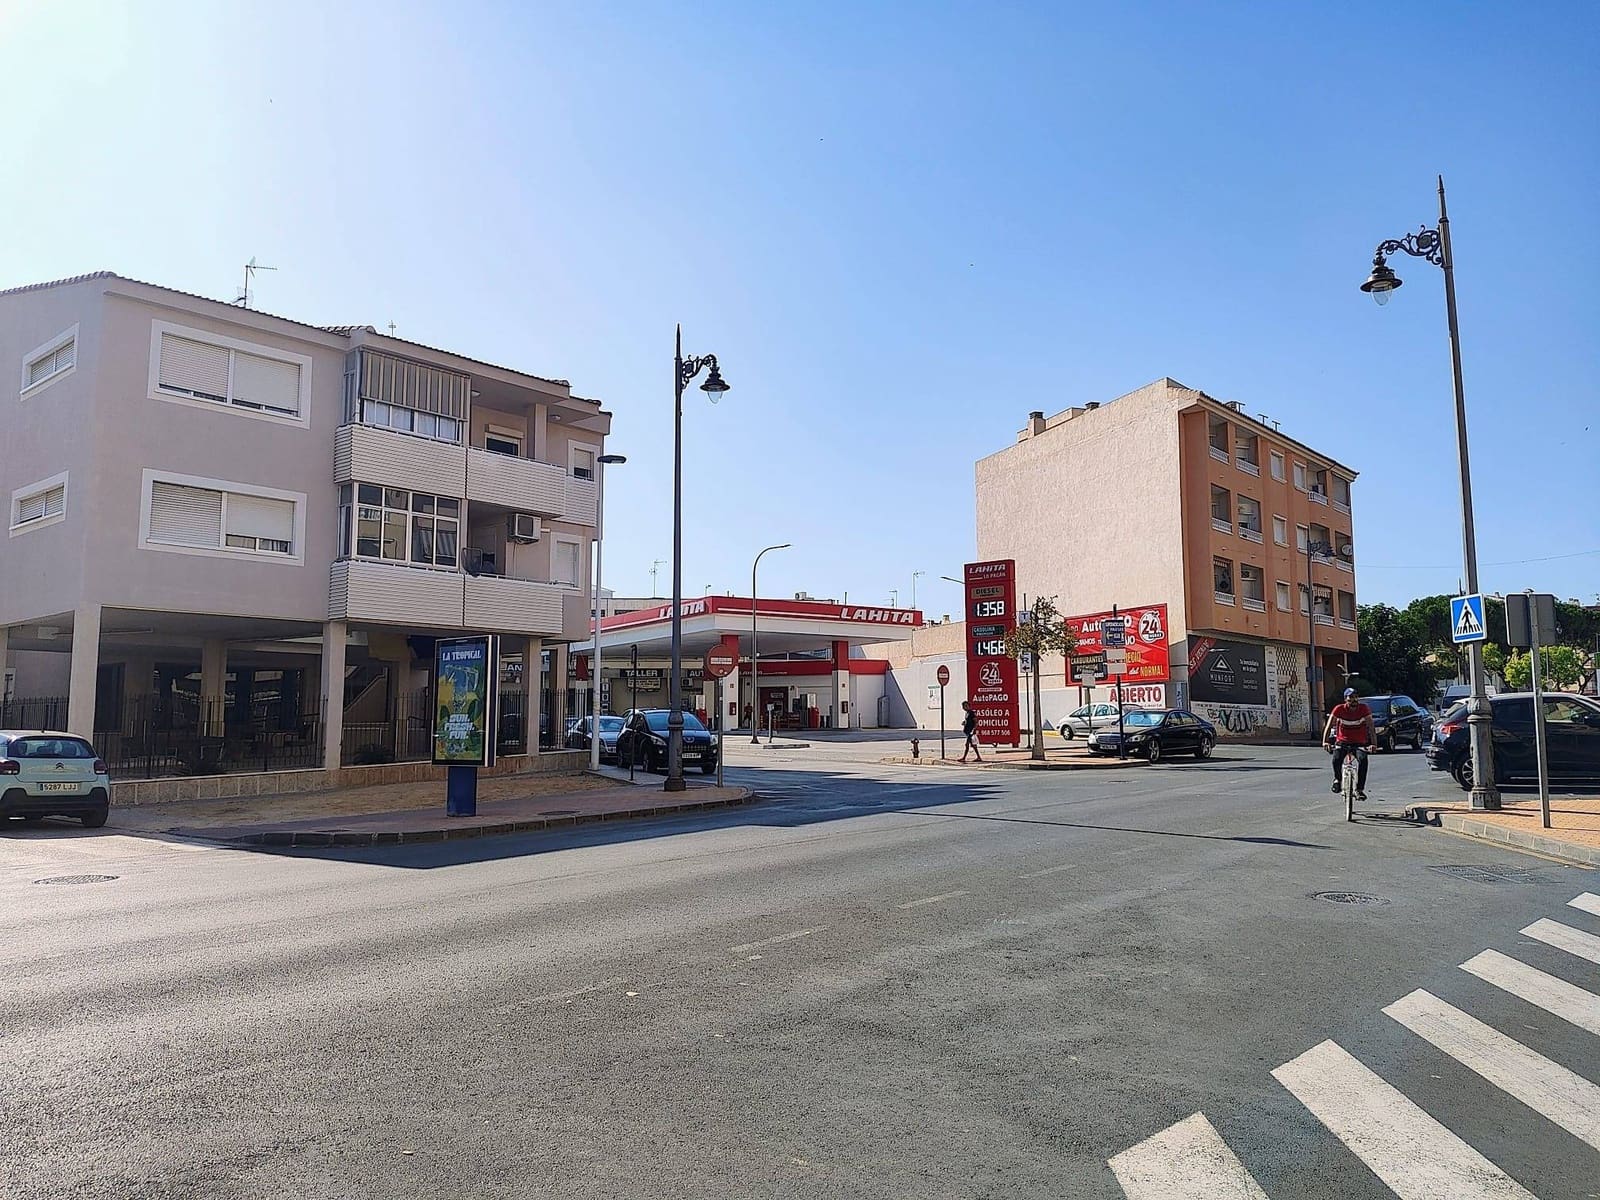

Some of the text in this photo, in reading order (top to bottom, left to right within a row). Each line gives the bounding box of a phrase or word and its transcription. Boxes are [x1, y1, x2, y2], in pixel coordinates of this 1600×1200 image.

[976, 587, 1000, 595] DIESEL
[977, 601, 1005, 617] 1.358
[1142, 618, 1158, 635] 24
[978, 640, 1005, 656] 1.468
[442, 649, 482, 661] LA TROPICAL
[982, 668, 997, 680] 24
[1140, 665, 1165, 676] NORMAL
[973, 693, 1009, 702] AutoPAGO
[1110, 686, 1162, 703] ABIERTO
[974, 708, 1010, 717] ASÓLEO A
[978, 719, 1009, 727] OMICILIO
